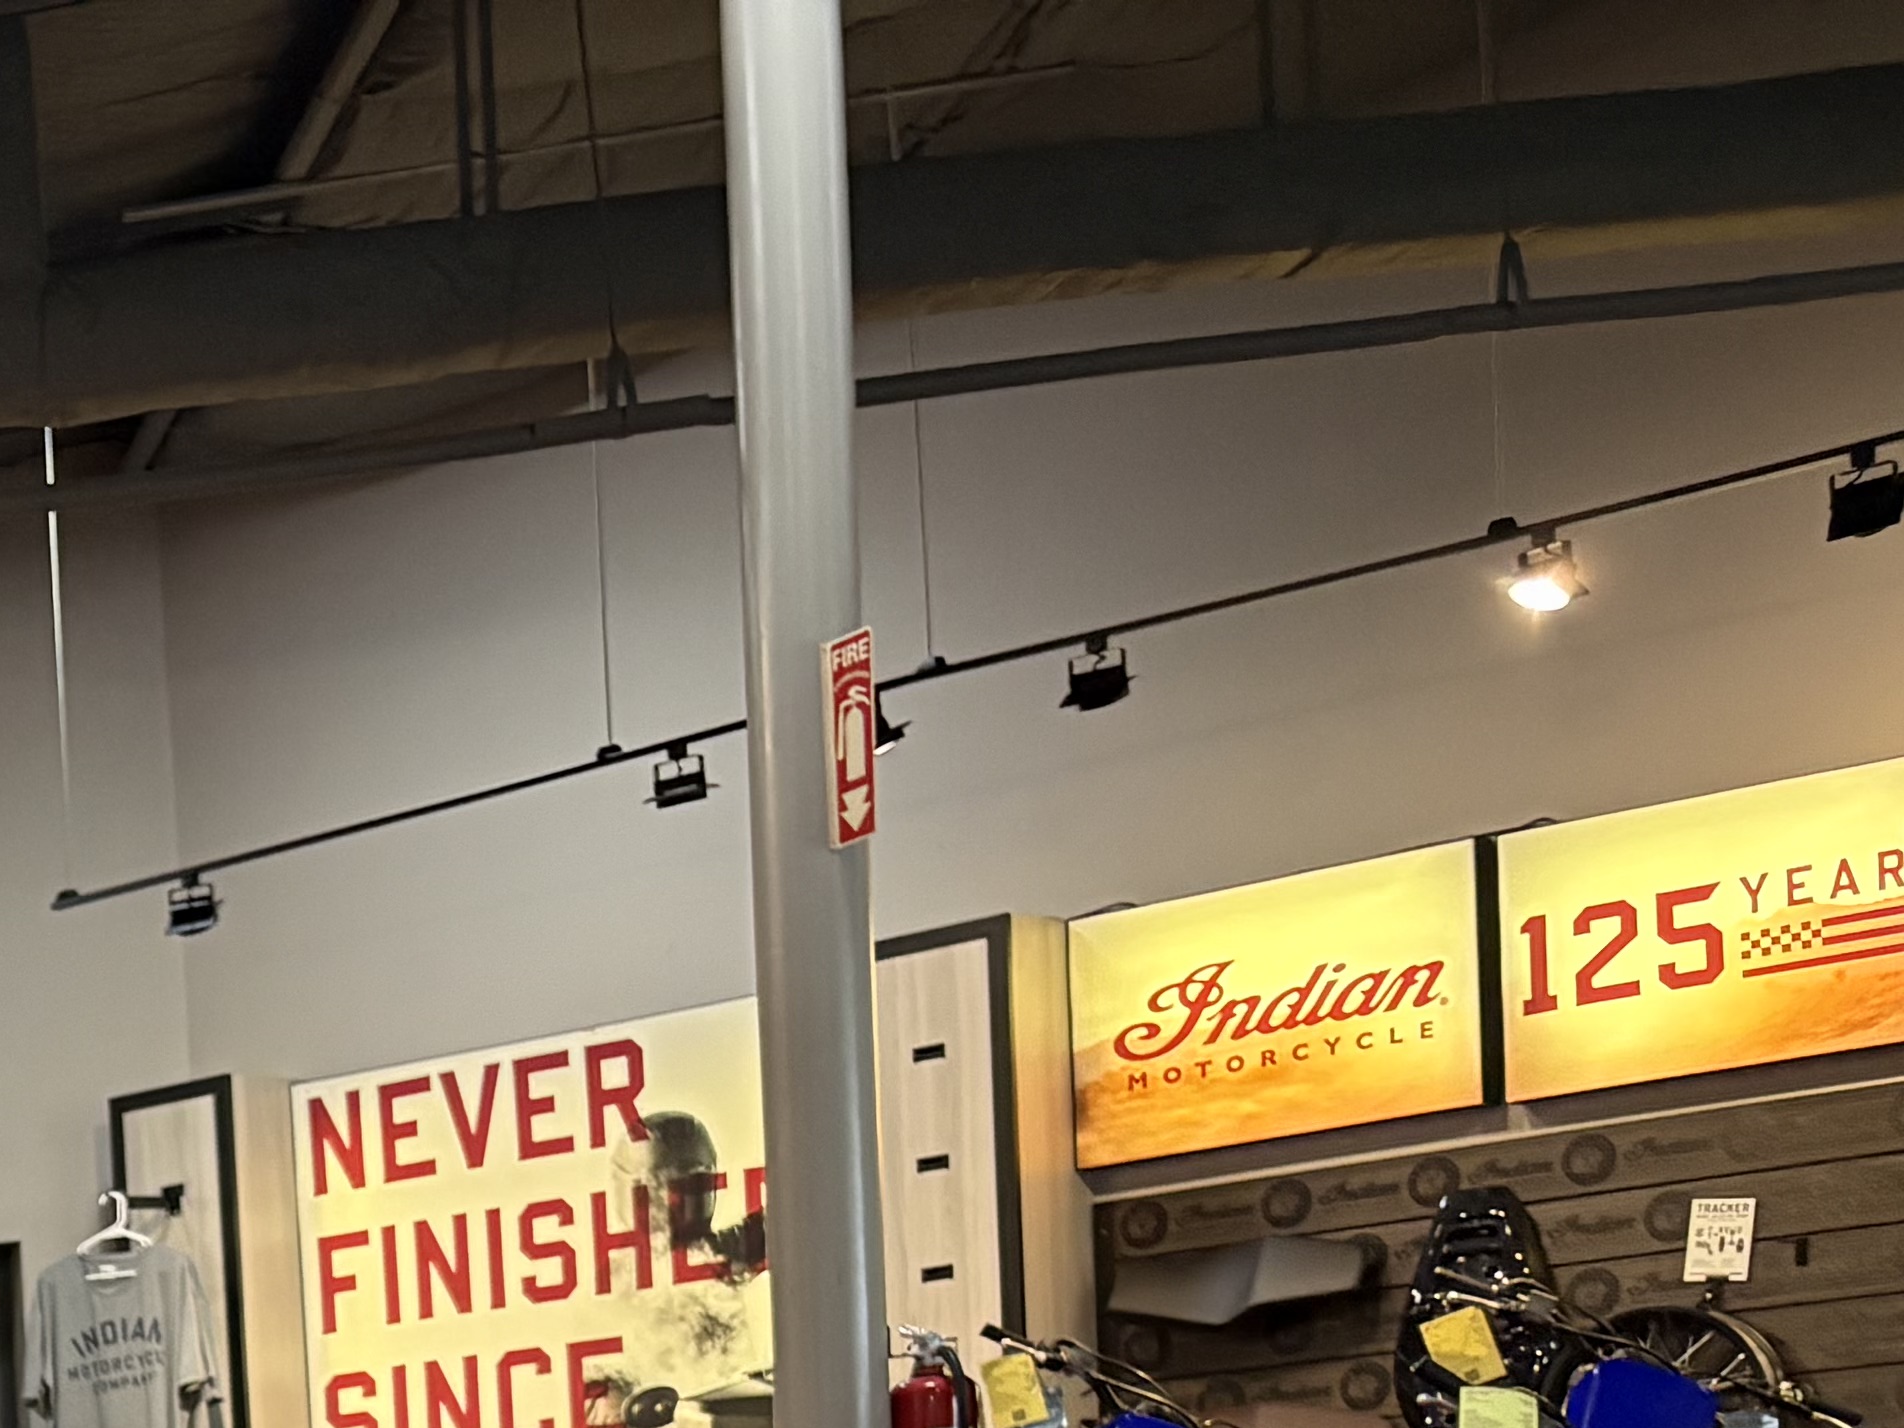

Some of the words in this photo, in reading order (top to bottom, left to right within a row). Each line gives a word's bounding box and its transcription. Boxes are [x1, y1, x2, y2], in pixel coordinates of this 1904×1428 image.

[831, 636, 871, 672] FIRE
[1519, 881, 1725, 1018] 125
[1113, 957, 1446, 1063] Indian
[1127, 1019, 1436, 1093] MOTORCYCLE
[307, 1037, 650, 1197] NEVER
[316, 1165, 769, 1336] FINISHE
[1697, 1202, 1750, 1213] TRACKER
[70, 1315, 163, 1358] INDIAN
